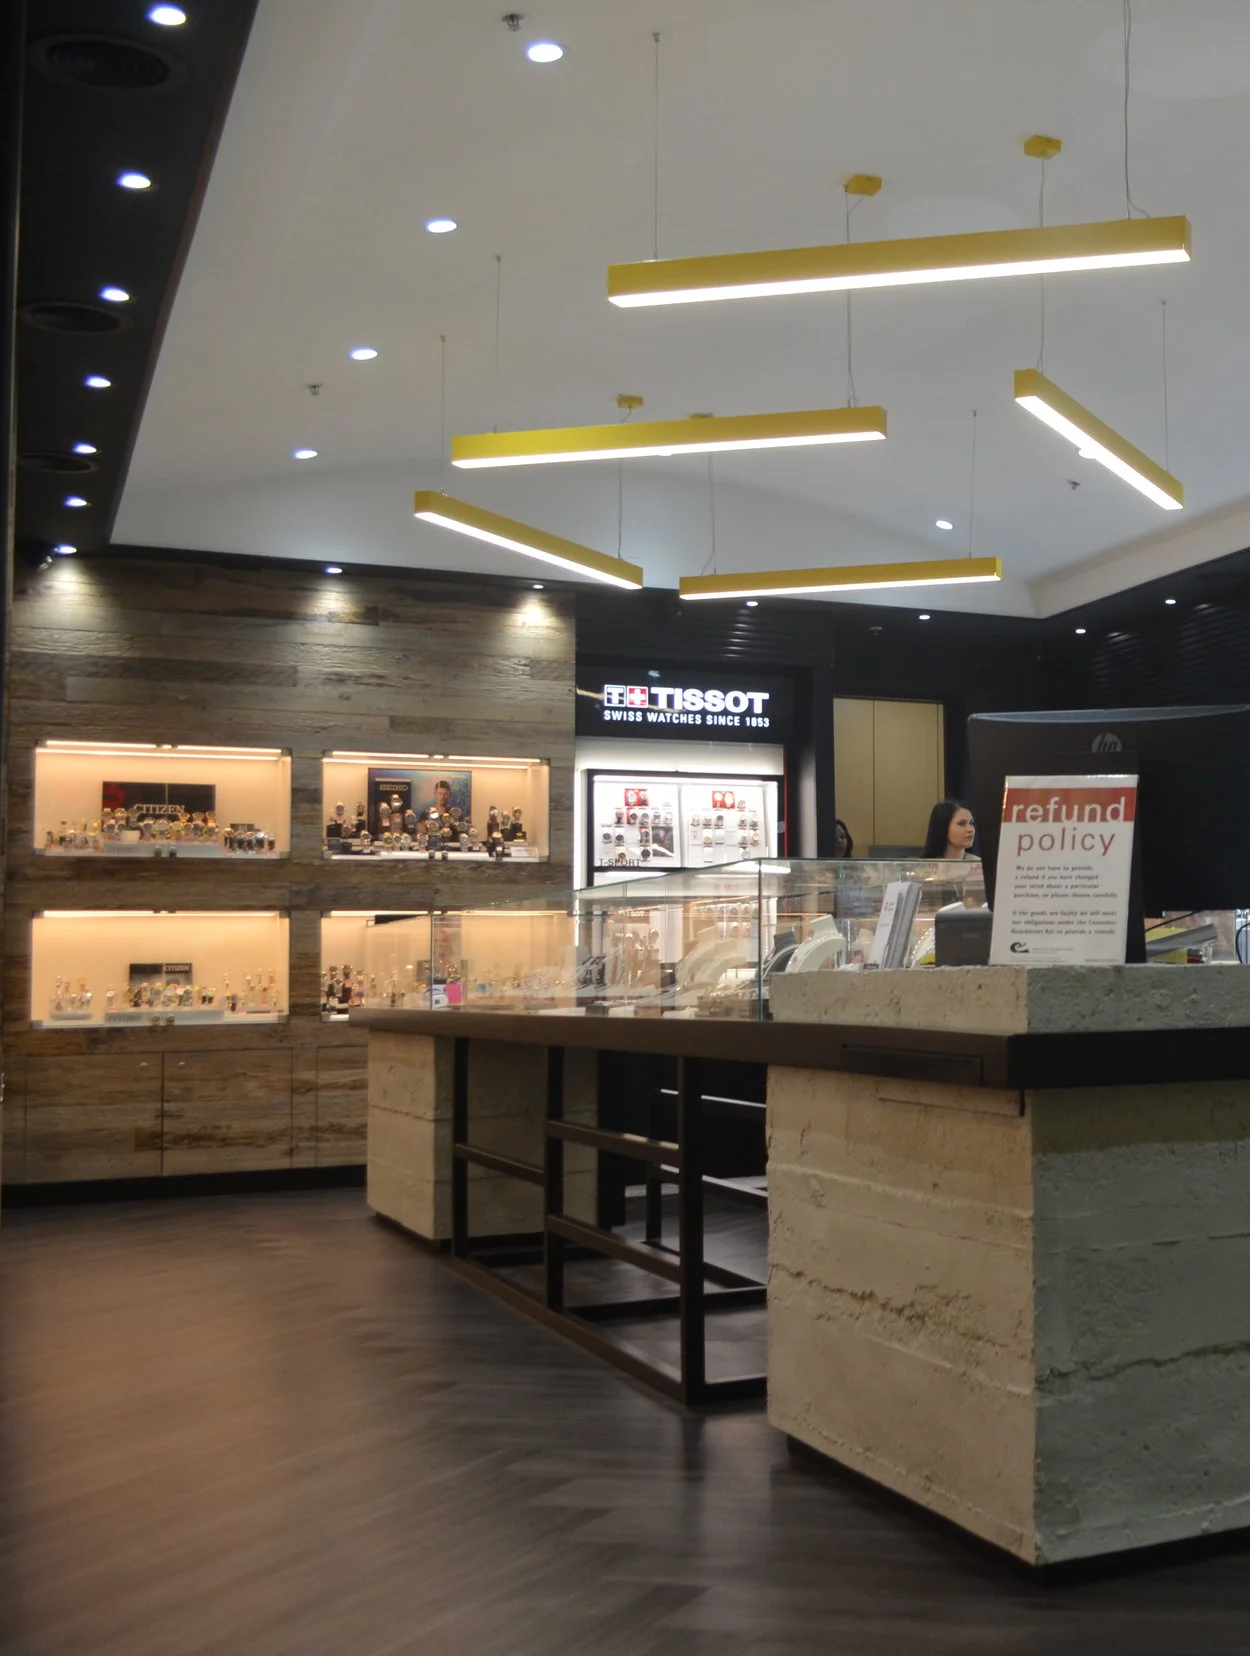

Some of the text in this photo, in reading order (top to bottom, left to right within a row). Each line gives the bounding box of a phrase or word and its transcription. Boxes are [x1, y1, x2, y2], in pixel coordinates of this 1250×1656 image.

[650, 686, 769, 714] TISSOT
[604, 709, 770, 727] SWISS WATCHES SINCE 1853
[134, 804, 185, 814] CITIZEN
[1012, 796, 1126, 823] refund
[1017, 827, 1116, 856] policy
